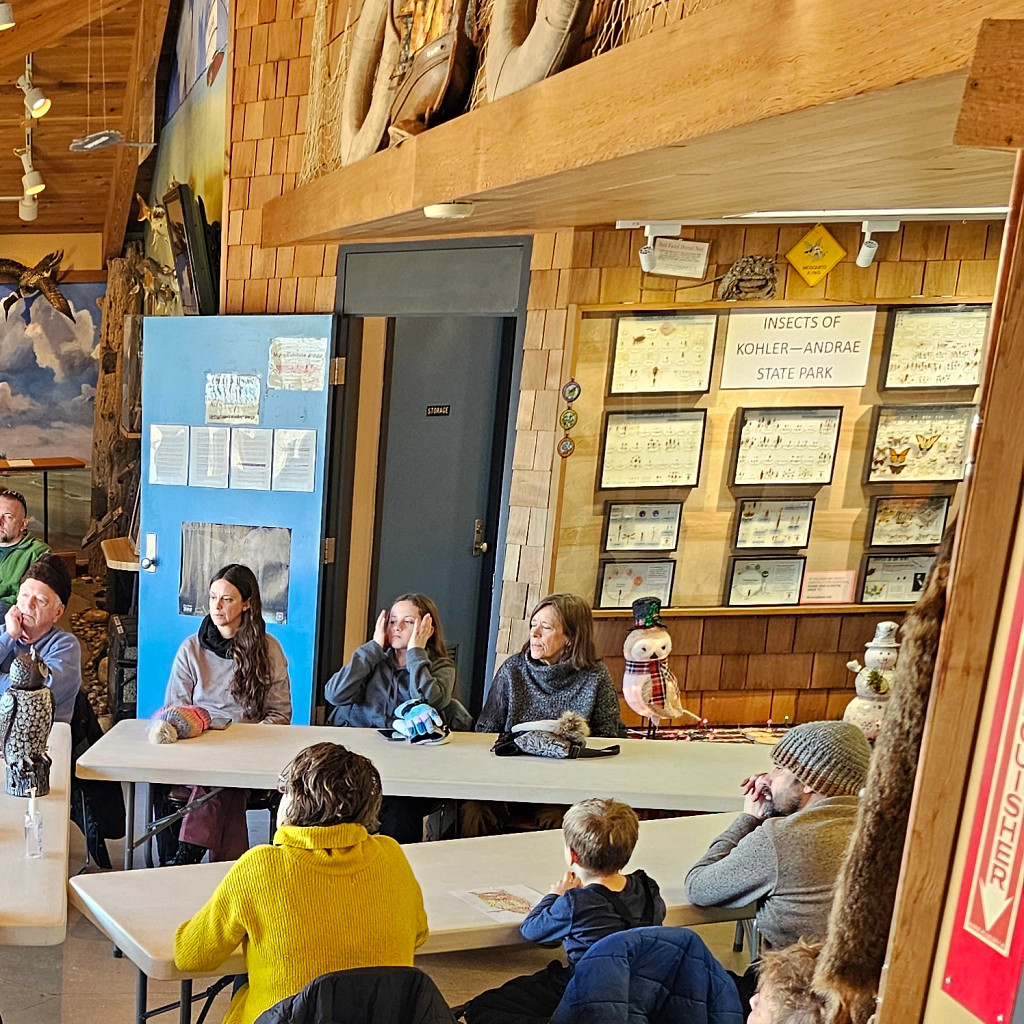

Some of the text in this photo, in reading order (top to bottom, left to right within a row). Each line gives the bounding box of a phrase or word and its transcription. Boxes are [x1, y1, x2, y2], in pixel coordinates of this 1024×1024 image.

[763, 315, 841, 330] INSECTS OF
[757, 366, 834, 381] STATE PARK
[427, 406, 449, 415] STORAGE
